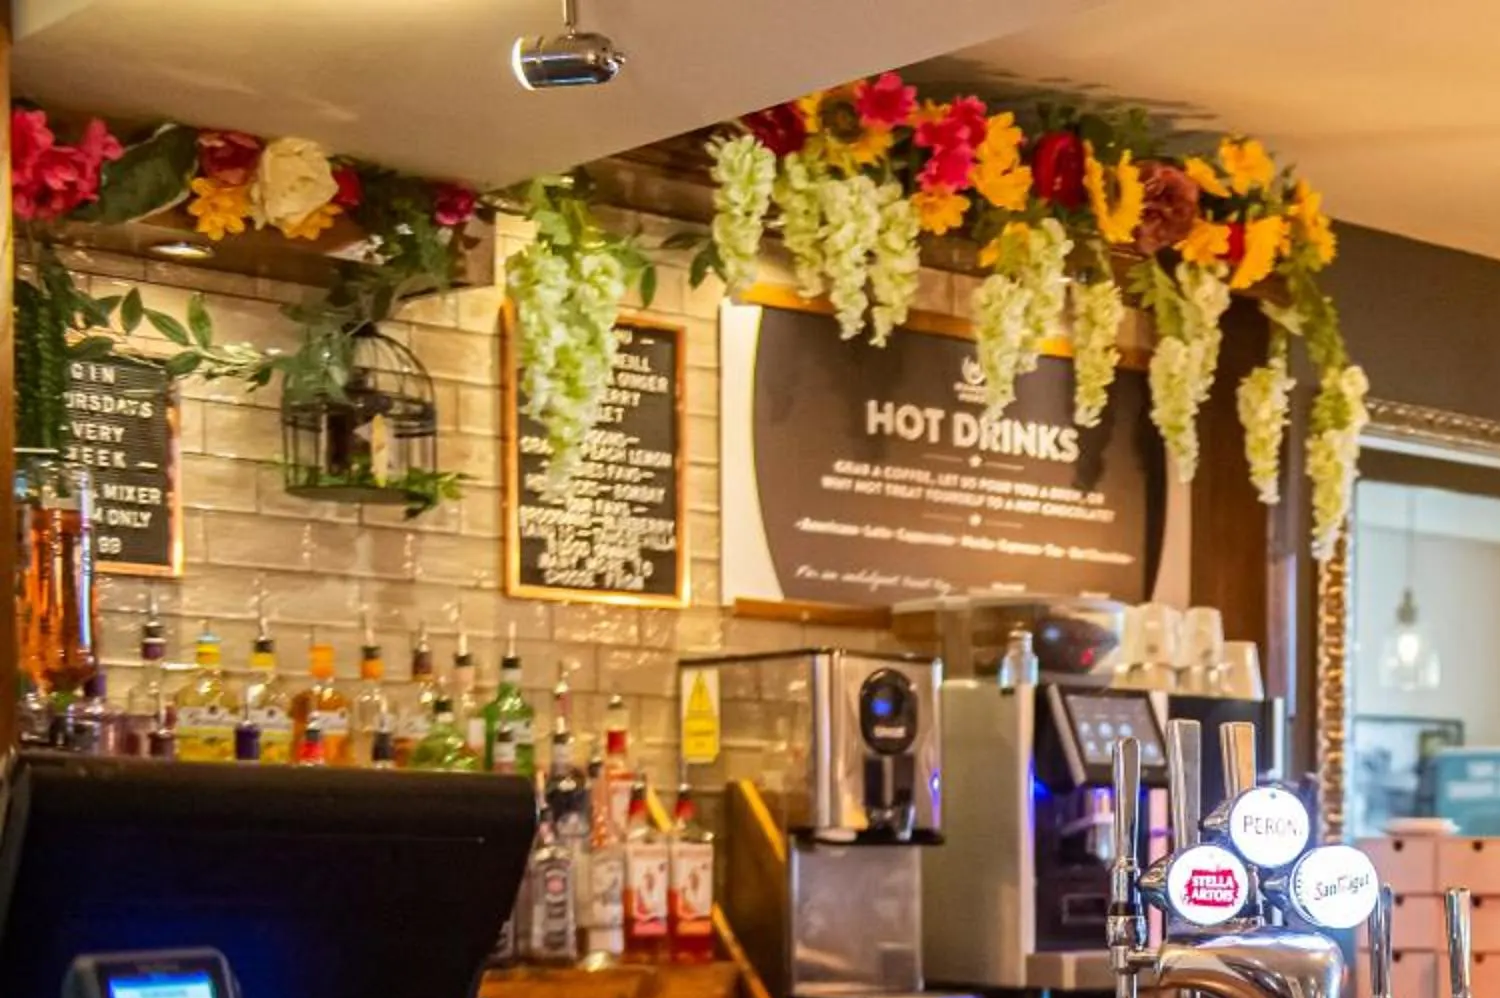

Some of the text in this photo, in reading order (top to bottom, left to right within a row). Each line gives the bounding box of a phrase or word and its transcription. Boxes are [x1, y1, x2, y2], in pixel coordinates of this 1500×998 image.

[70, 363, 116, 384] GIN
[866, 400, 1080, 463] HOT DRINKS
[871, 465, 882, 478] A
[938, 473, 959, 487] LET
[102, 483, 161, 505] MIXER
[854, 479, 882, 495] NOT
[106, 508, 153, 528] ONLY
[1191, 875, 1235, 888] STELLA
[1191, 888, 1236, 902] ARTOIS
